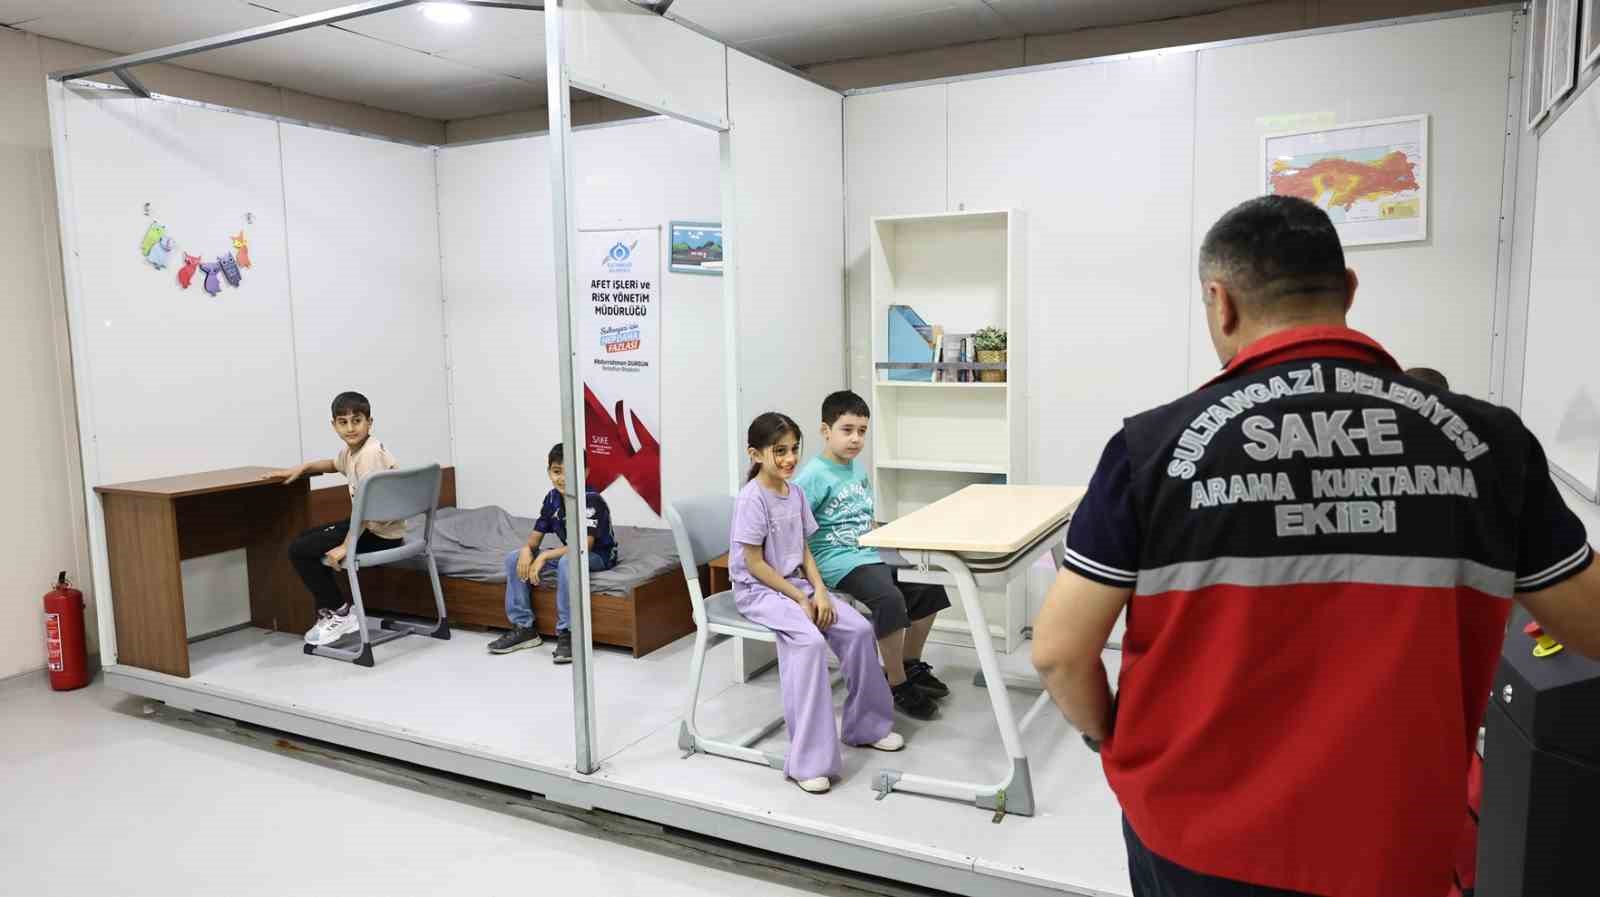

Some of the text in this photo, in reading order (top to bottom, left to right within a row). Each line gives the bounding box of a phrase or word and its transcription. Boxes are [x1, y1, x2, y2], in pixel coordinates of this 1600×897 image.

[591, 280, 651, 290] AFET İŞLERİ ve
[591, 291, 650, 303] RİSK YÖNETİM
[595, 304, 647, 316] MÜDÜRLÜĞÜ
[1167, 363, 1490, 480] SULTANGAZİ BELEDİYESİ
[1241, 408, 1404, 462] SAK-E
[1190, 464, 1479, 510] ARAMA KURTARMA
[1275, 500, 1397, 537] EKİBİ
